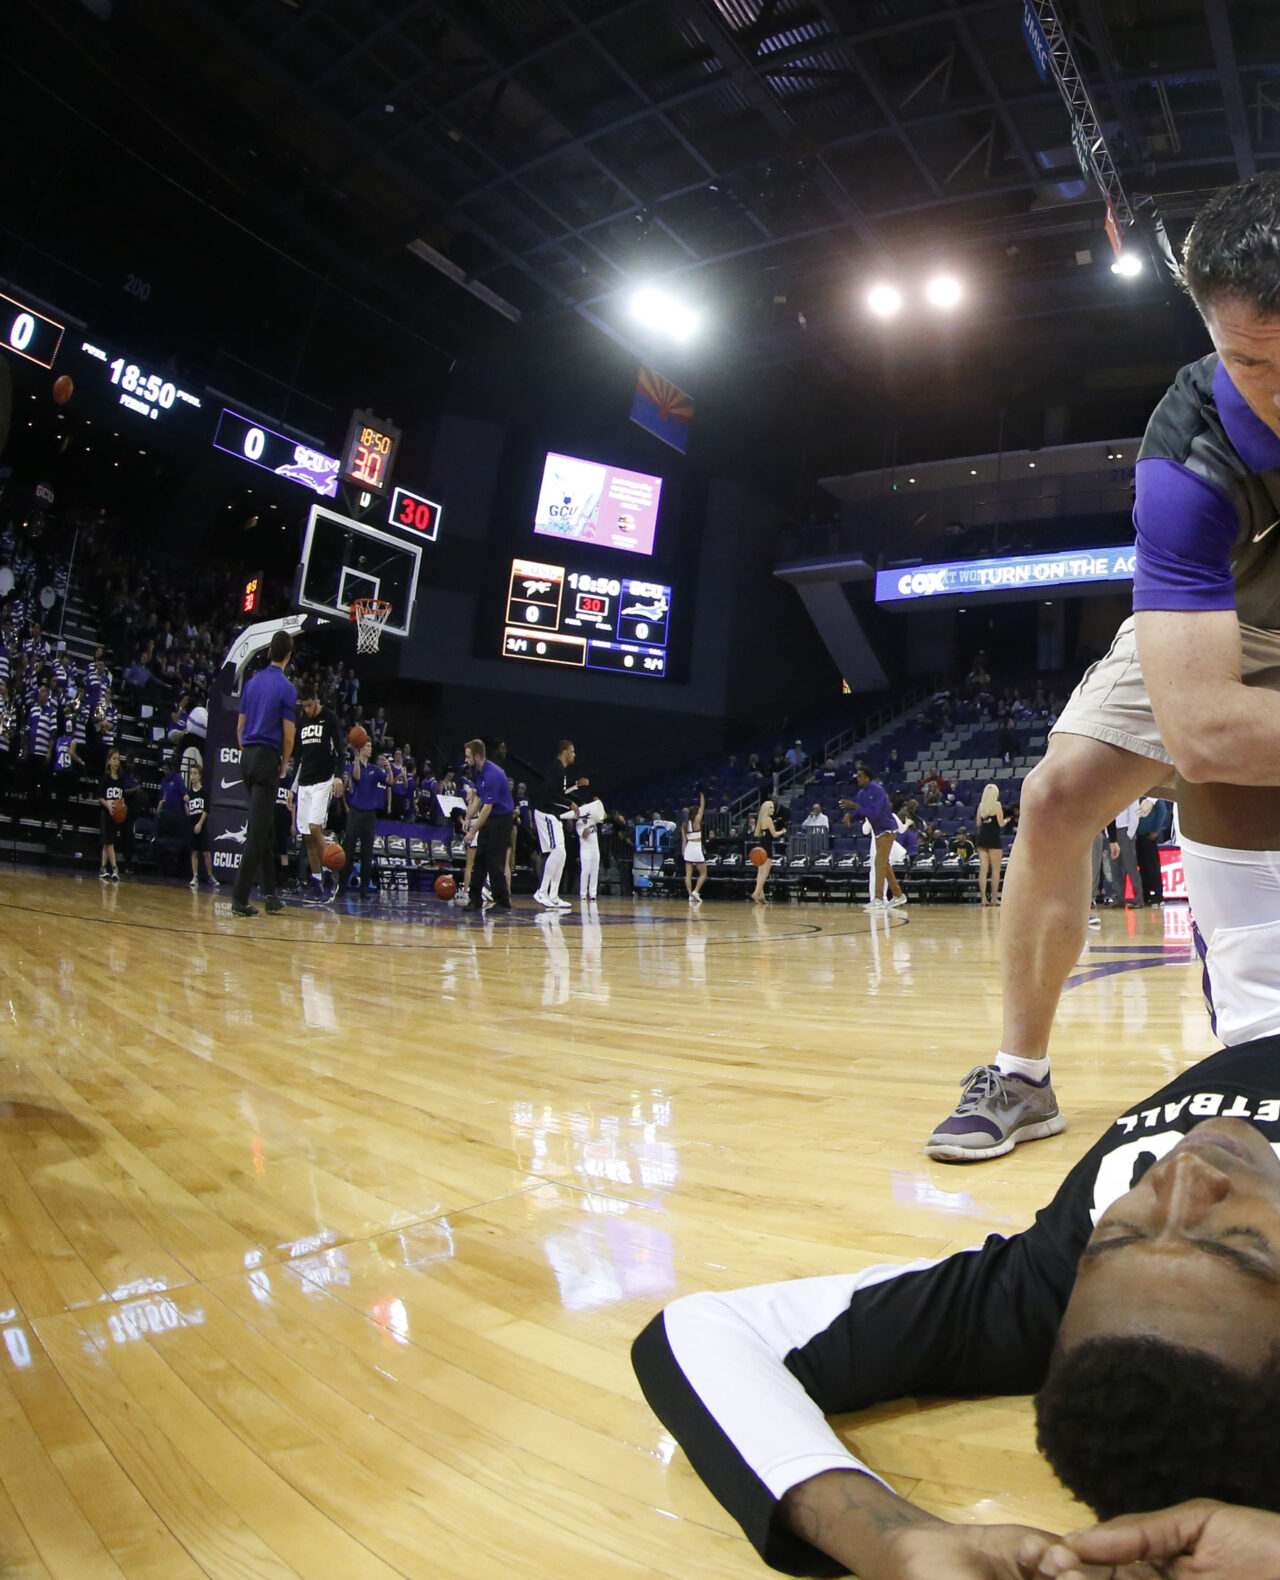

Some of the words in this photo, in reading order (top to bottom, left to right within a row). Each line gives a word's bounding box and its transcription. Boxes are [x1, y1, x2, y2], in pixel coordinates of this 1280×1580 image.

[1024, 5, 1048, 70] UMKC
[122, 274, 151, 300] 200
[9, 313, 35, 350] 0
[110, 358, 176, 409] 18:50
[244, 427, 265, 460] 0
[360, 427, 391, 455] 18:50
[351, 446, 382, 486] 30
[400, 498, 430, 530] 30
[567, 573, 621, 596] 18:50
[898, 571, 949, 595] COX
[980, 564, 1029, 585] TURN
[1034, 561, 1065, 580] ON
[1068, 557, 1108, 576] THE
[629, 581, 664, 599] GCU
[525, 606, 539, 622] 0
[582, 598, 602, 612] 30
[635, 623, 649, 639] 0
[506, 638, 528, 652] 3/1
[536, 642, 546, 654] 0
[624, 655, 634, 667] 0
[644, 657, 664, 670] 3/1
[301, 725, 323, 739] GCU
[106, 787, 123, 798] GCU
[278, 788, 289, 799] CU
[189, 798, 204, 810] GCU
